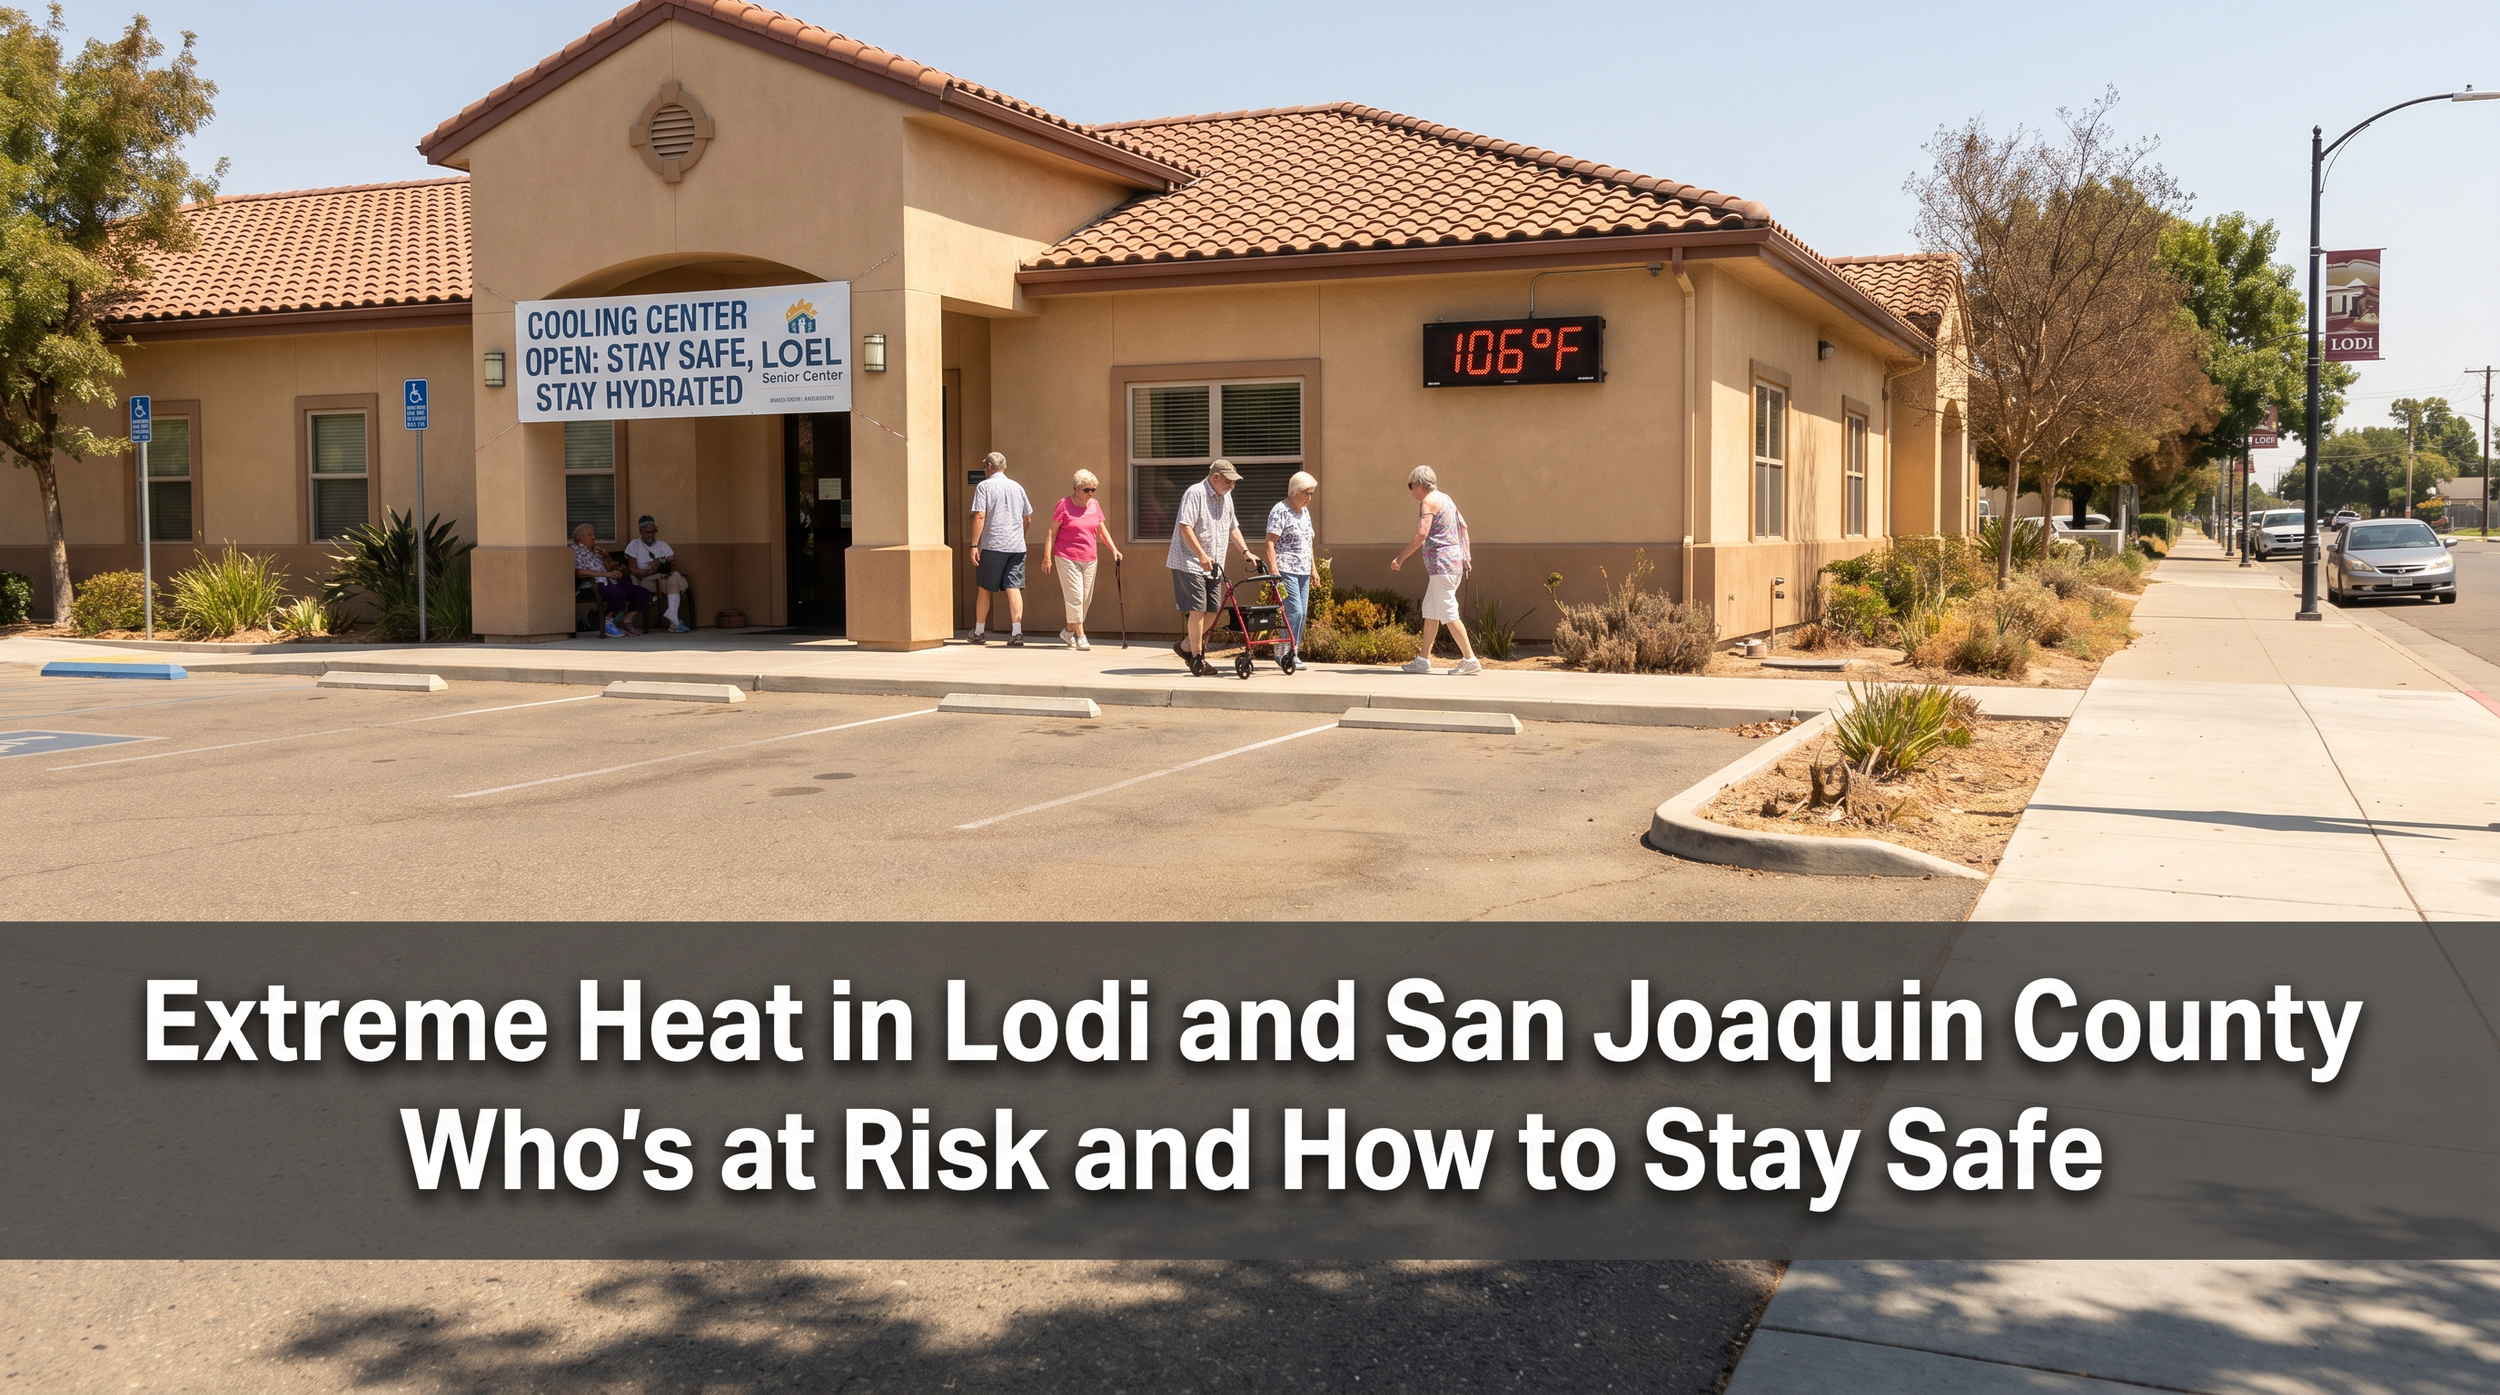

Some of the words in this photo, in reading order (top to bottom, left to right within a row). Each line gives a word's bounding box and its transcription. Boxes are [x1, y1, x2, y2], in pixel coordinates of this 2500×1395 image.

[528, 305, 637, 341] COOLING
[645, 300, 748, 335] CENTER
[525, 346, 600, 377] OPEN:
[607, 341, 671, 373] STAY
[678, 337, 753, 373] SAFE,
[762, 337, 842, 369] LOEL
[1454, 326, 1583, 375] 106°F
[2331, 337, 2374, 351] LODI
[536, 381, 598, 412] STAY
[606, 375, 744, 410] HYDRATED
[762, 372, 800, 384] Senior
[803, 370, 843, 382] Center
